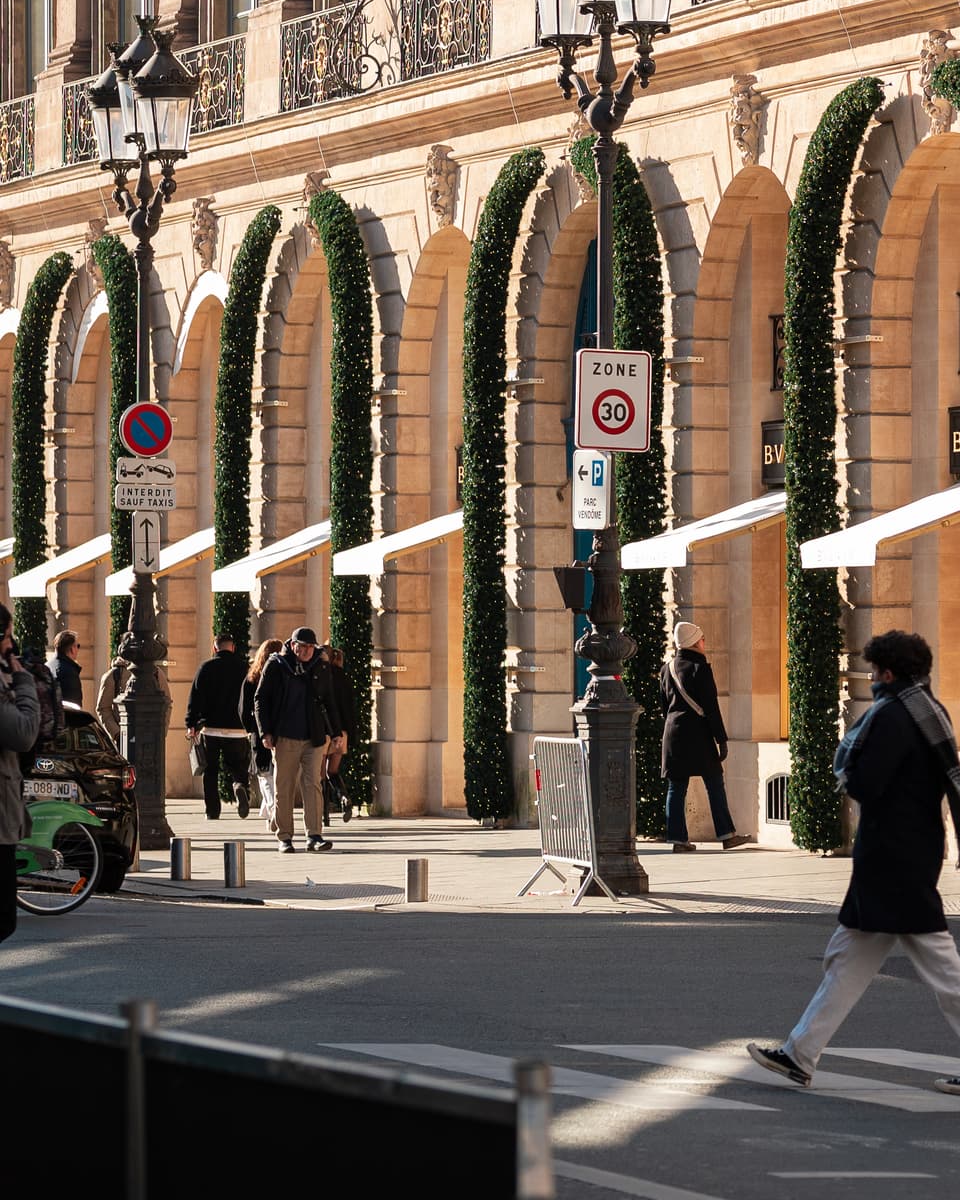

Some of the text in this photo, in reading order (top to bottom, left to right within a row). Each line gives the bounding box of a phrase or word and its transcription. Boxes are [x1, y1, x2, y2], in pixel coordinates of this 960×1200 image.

[592, 362, 637, 377] ZONE
[601, 402, 627, 422] 30
[122, 488, 172, 497] INTERDIT
[120, 498, 174, 507] SAUF TAXIS
[583, 497, 597, 507] PARC
[578, 509, 602, 519] VENDÔME
